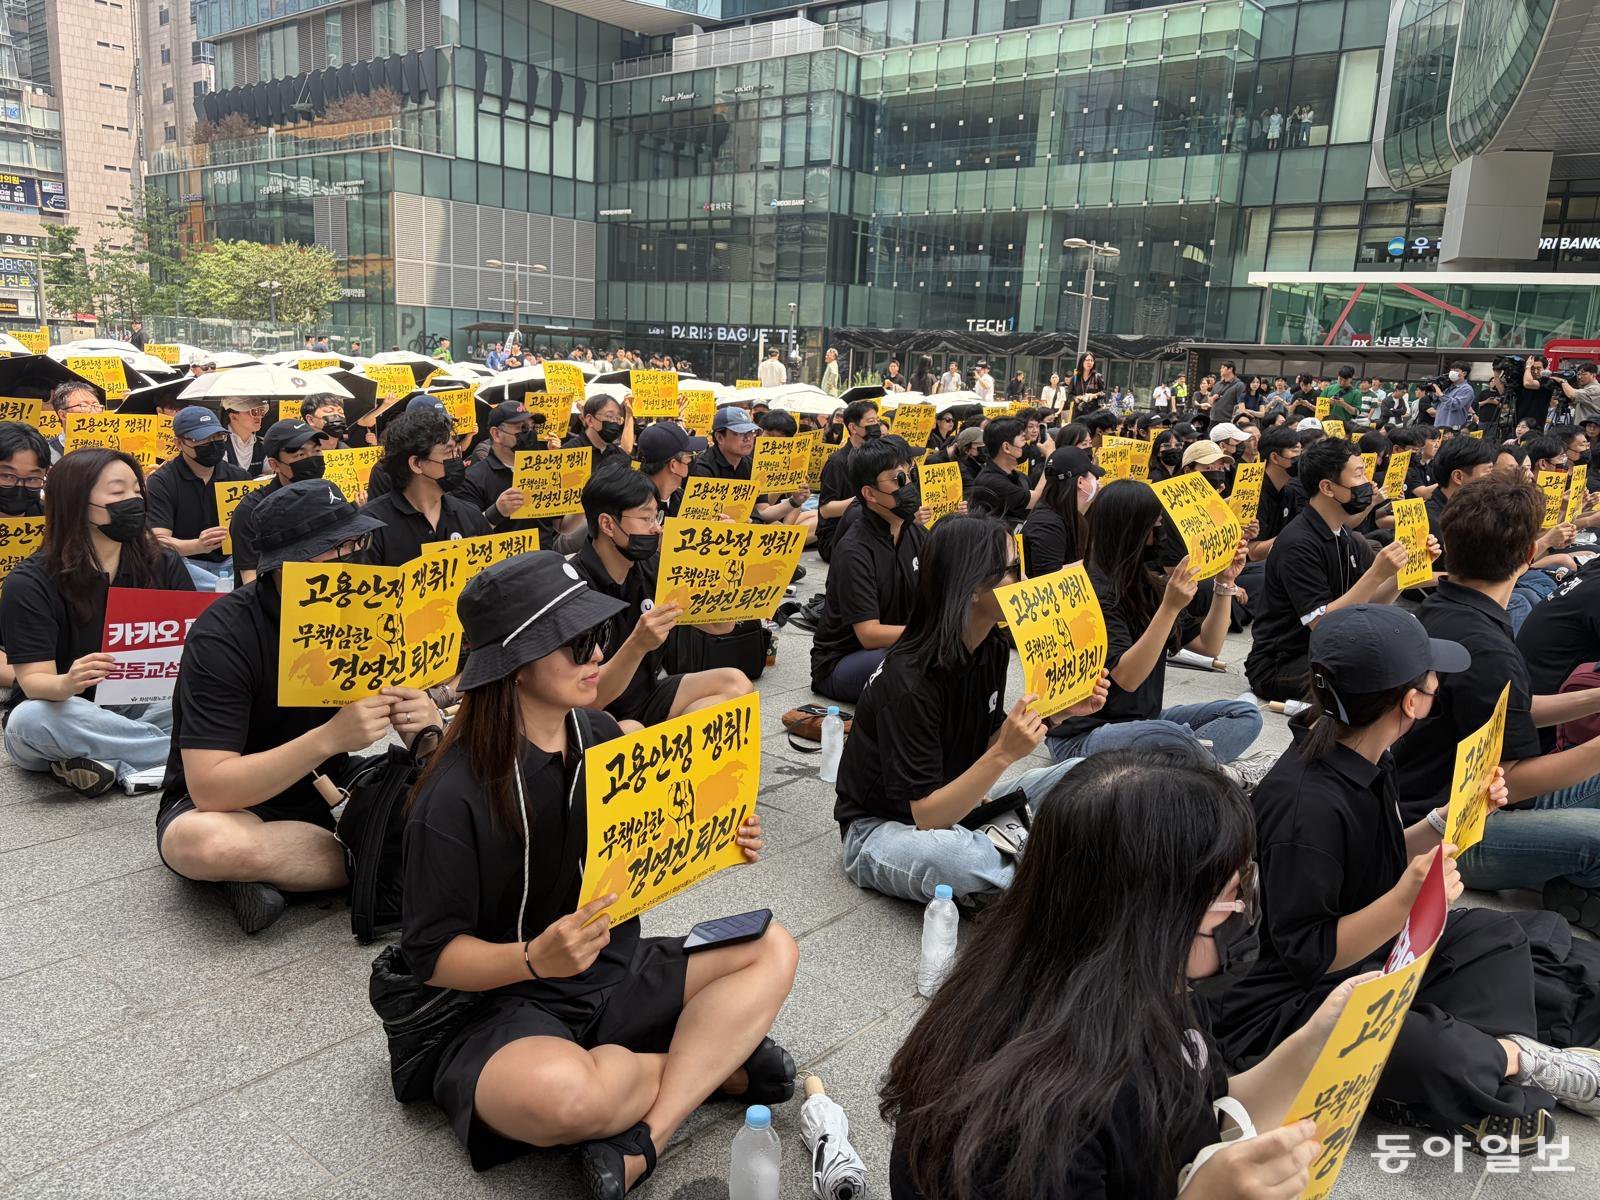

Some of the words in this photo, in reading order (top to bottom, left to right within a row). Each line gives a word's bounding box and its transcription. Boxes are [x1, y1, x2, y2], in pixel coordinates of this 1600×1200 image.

[1560, 237, 1600, 250] BANK
[1374, 336, 1428, 348] 신분당선
[73, 417, 120, 433] 고용안정
[125, 418, 152, 433] 쟁취!
[324, 452, 355, 467] 용안정
[760, 440, 794, 455] 고용안정
[520, 453, 563, 471] 고용안정
[566, 451, 588, 468] 쟁취!
[517, 477, 548, 491] 무책임한
[689, 481, 730, 501] 고용안정
[731, 483, 756, 502] 쟁취!
[766, 472, 790, 487] 경영진
[531, 489, 561, 509] 경영진
[1161, 480, 1197, 510] 고용안정
[1241, 501, 1259, 519] 경영
[673, 527, 752, 557] 고용안정
[757, 529, 800, 557] 쟁취!
[1199, 529, 1222, 564] 경영진
[1220, 522, 1239, 554] 퇴진!
[299, 571, 406, 609] 고용안정
[411, 558, 457, 596] 쟁취!
[667, 565, 721, 588] 무책임한
[690, 587, 740, 616] 경영진
[736, 586, 780, 612] 퇴진!
[1009, 581, 1060, 626] 고용안정
[1057, 574, 1091, 609] 쟁취!
[108, 620, 180, 646] 카카오
[292, 623, 374, 650] 무책임한
[329, 650, 407, 692] 경영진
[410, 633, 456, 679] 퇴진!
[1024, 634, 1058, 665] 무책임한
[105, 661, 180, 680] 공동교섭
[1045, 654, 1078, 700] 경영진
[1077, 645, 1104, 683] 퇴진!
[601, 724, 693, 805] 고용안정
[702, 706, 752, 762] 쟁취!
[598, 807, 666, 861] 무책임한
[627, 829, 694, 899] 경영진
[690, 804, 748, 864] 퇴진!
